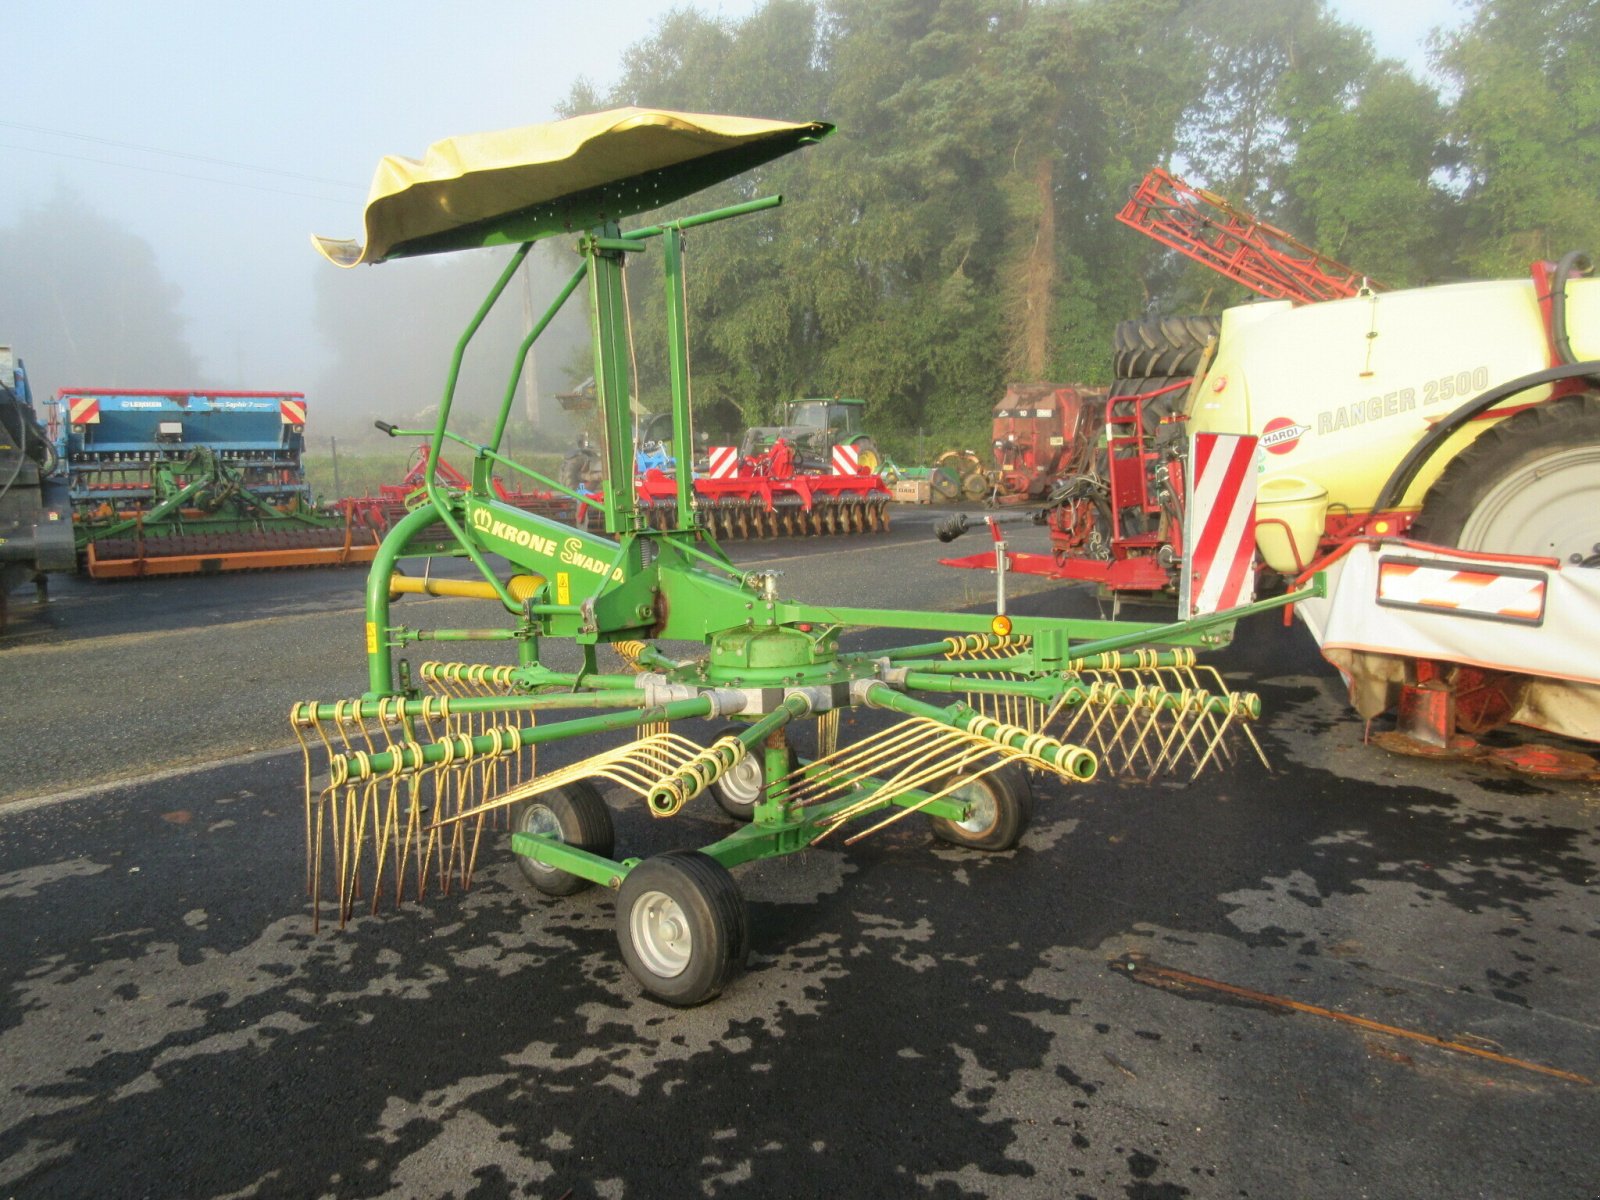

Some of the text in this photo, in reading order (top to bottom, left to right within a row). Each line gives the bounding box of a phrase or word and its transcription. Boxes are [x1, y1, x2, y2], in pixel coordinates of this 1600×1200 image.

[1317, 366, 1488, 435] RANGER 2500
[1263, 428, 1298, 444] HARDI
[491, 520, 558, 558] KRONE
